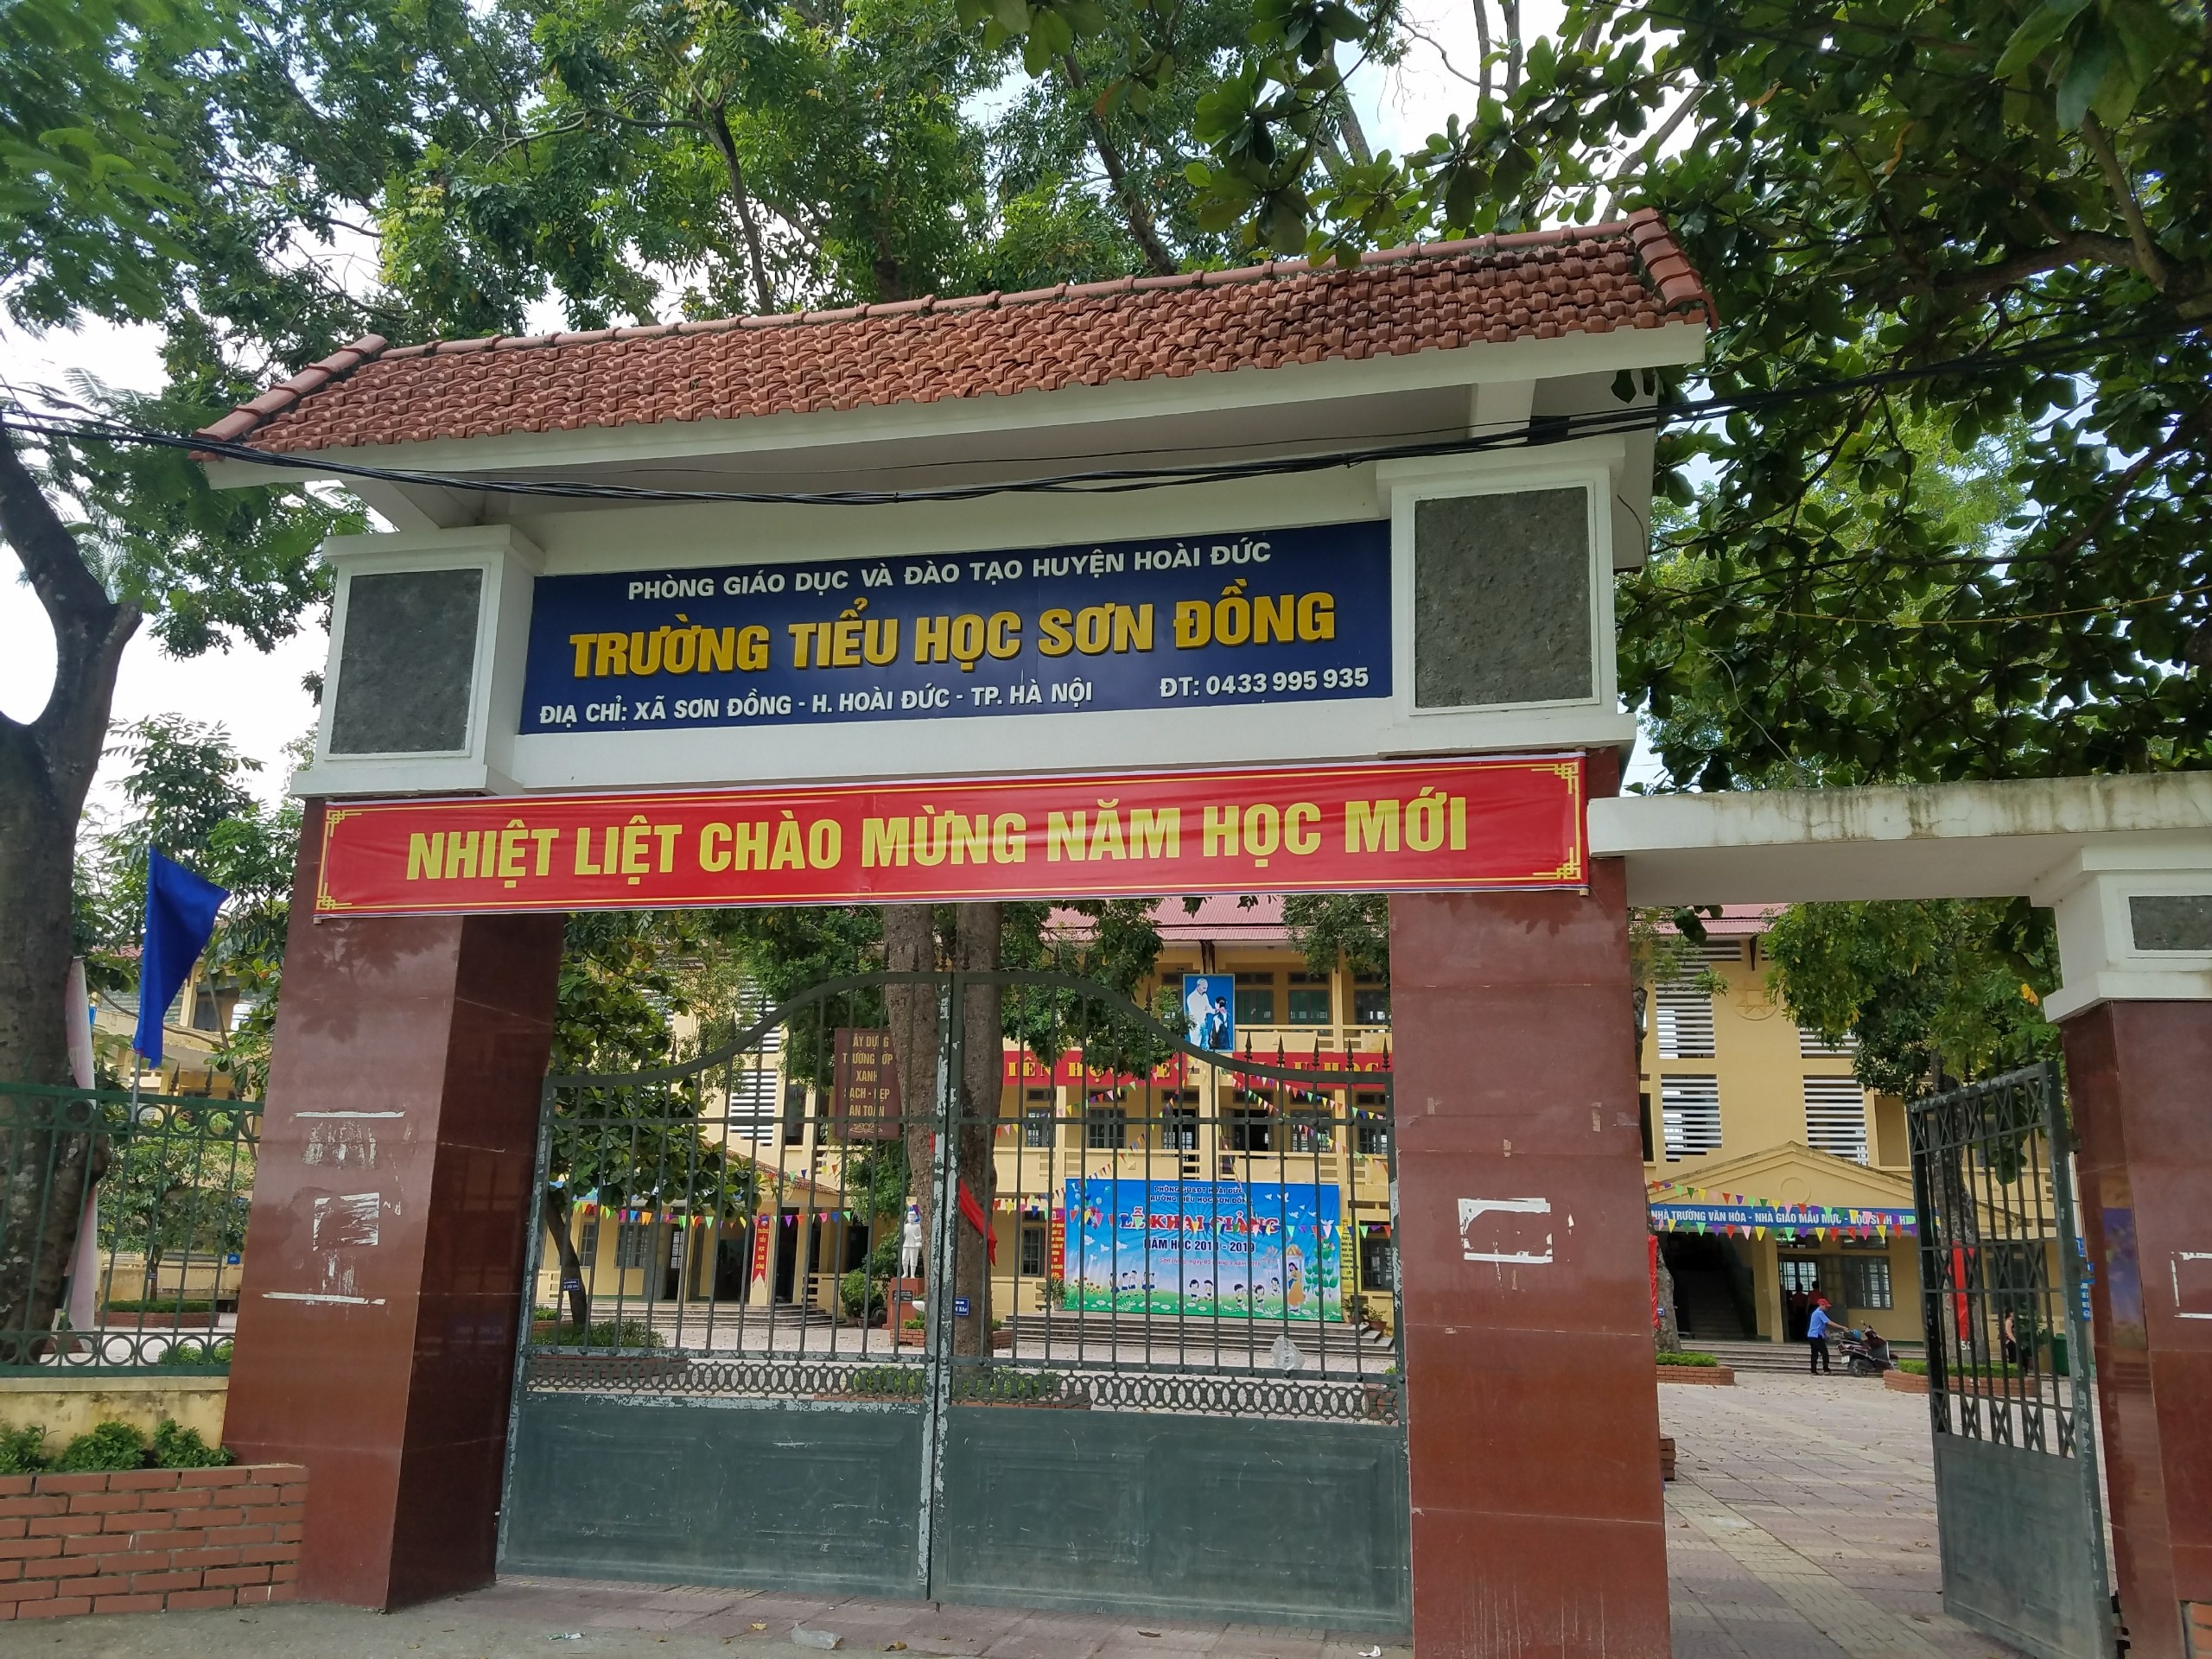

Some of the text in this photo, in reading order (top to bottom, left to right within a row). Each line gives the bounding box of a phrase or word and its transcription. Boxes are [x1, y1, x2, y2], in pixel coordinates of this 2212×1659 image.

[628, 537, 1271, 600] PHÒNG GIÁO DỤC VÀ ĐÀO TẠO HUYỆN HOÀI ĐỨC
[569, 577, 1336, 678] TRƯỜNG TIỂU HỌC SƠN ĐỒNG
[1160, 666, 1370, 697] ĐT: 0433 995 935
[585, 695, 627, 722] CHỈ:
[633, 695, 666, 721] XÃ
[674, 698, 719, 719] SƠN
[727, 688, 791, 717] ĐỒNG
[812, 693, 833, 713] H.
[839, 685, 893, 712] HOÀI
[901, 683, 950, 709] ĐỨC
[971, 686, 1002, 706] TP.
[1009, 678, 1043, 705] HÀ
[1052, 677, 1093, 708] NỘI
[406, 791, 1467, 888] NHIỆT LIỆT CHÀO MỪNG NĂM HỌC MỚI
[866, 1035, 889, 1051] DỰG
[842, 1050, 875, 1065] TƯỜNG
[1007, 1056, 1052, 1077] IÊN
[1068, 1062, 1122, 1084] HỌ
[844, 1088, 867, 1101] ẠCH
[874, 1088, 891, 1102] ẸP
[849, 1105, 861, 1116] AN
[1671, 1209, 1707, 1222] TRƯỜNG
[1708, 1209, 1726, 1222] VĂN
[1728, 1210, 1747, 1223] HÓA
[1755, 1210, 1772, 1223] NHÀ
